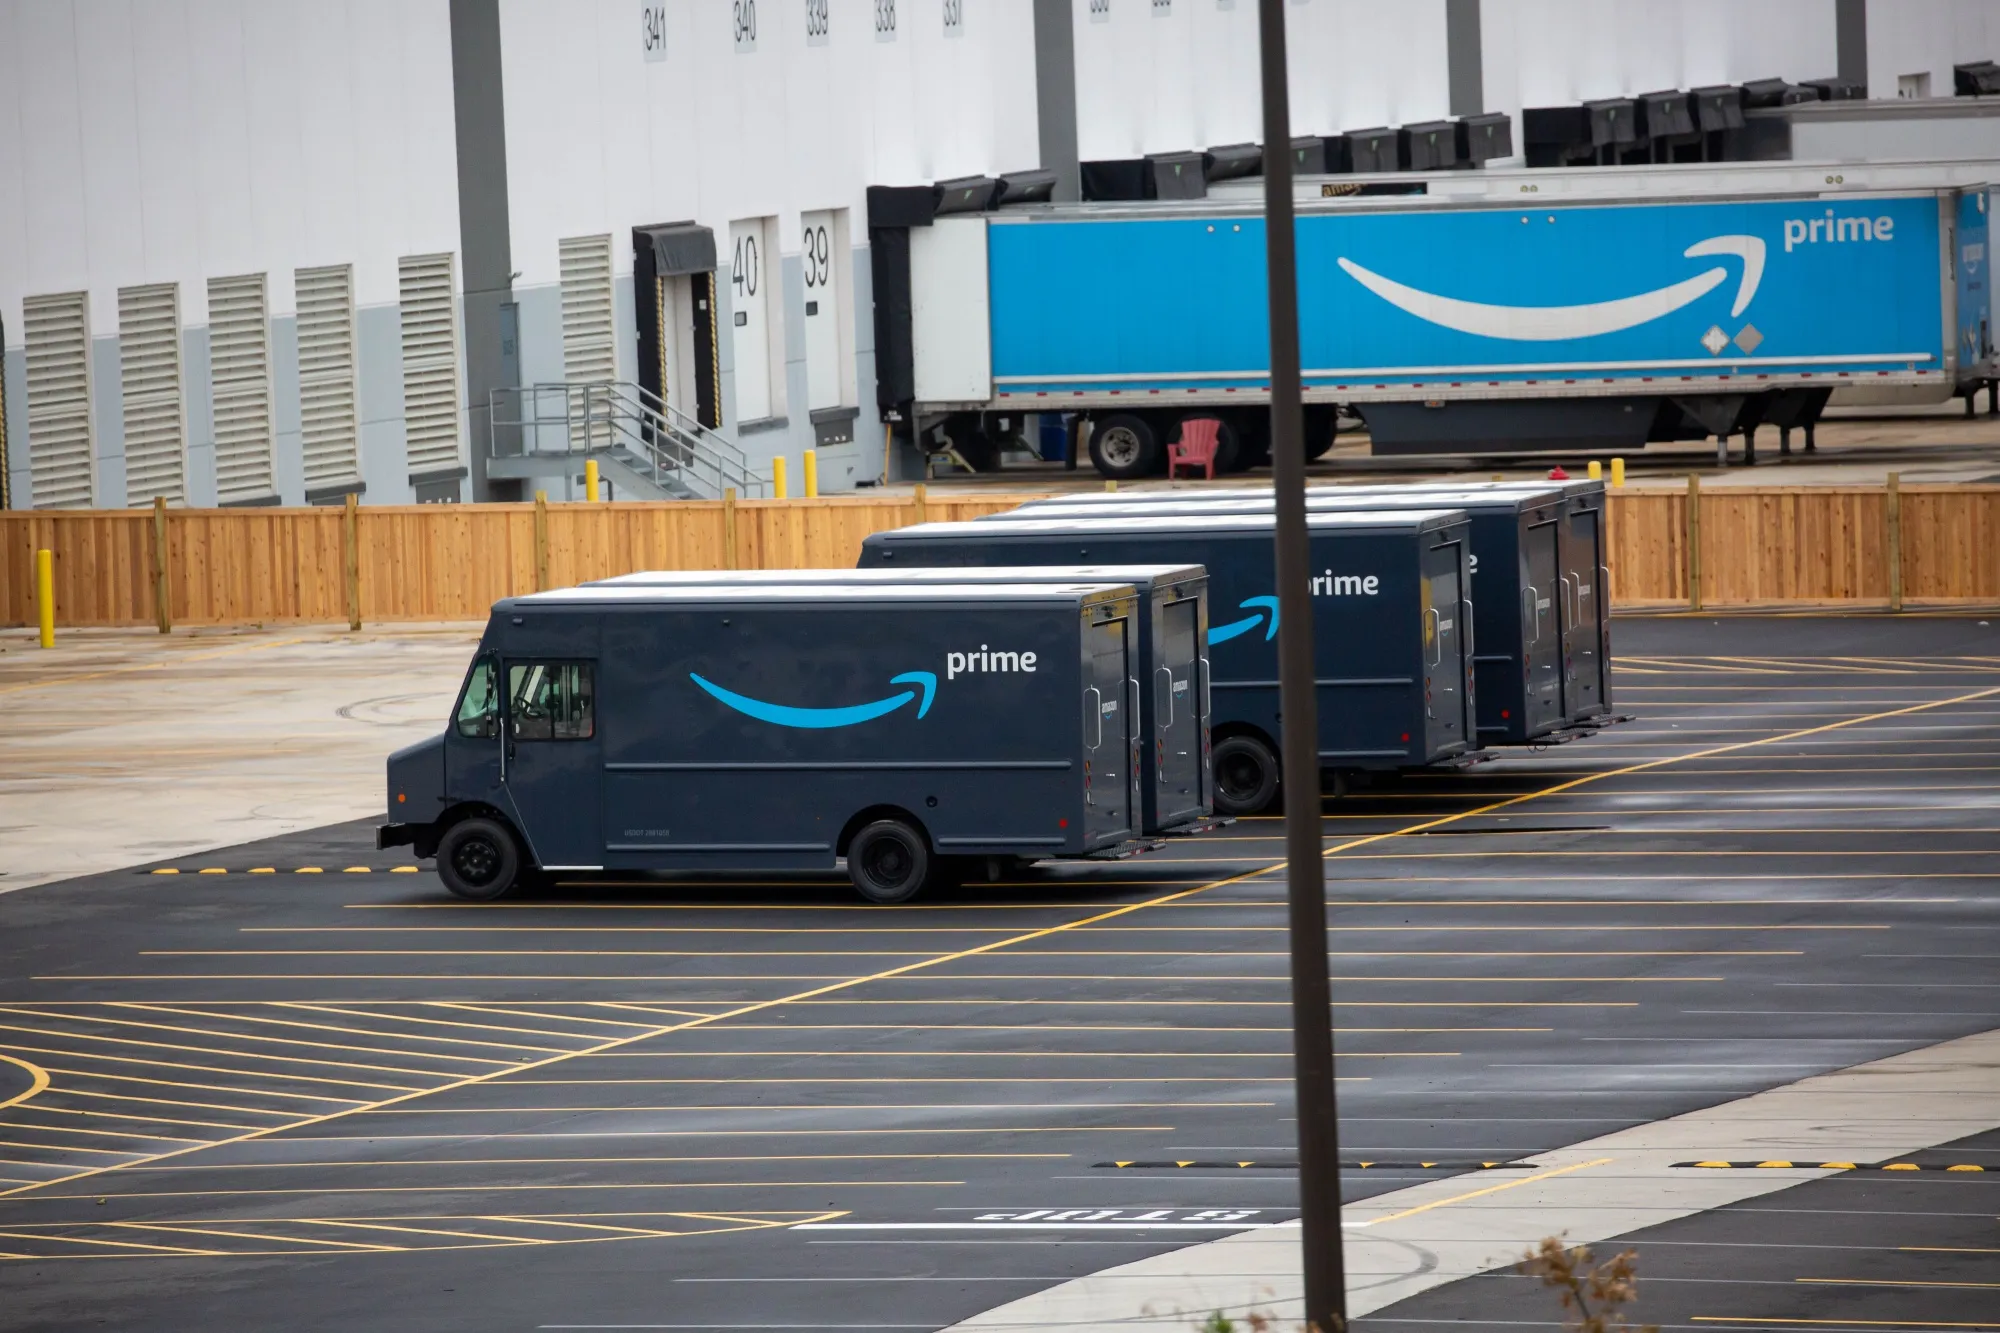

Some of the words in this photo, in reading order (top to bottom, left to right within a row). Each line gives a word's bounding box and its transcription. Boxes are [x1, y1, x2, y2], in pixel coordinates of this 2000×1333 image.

[644, 7, 667, 51] 341
[734, 0, 757, 42] 340
[1783, 208, 1895, 252] prime
[732, 235, 758, 297] 40
[804, 225, 829, 288] 39
[1308, 568, 1379, 596] rime
[947, 643, 1037, 680] prime
